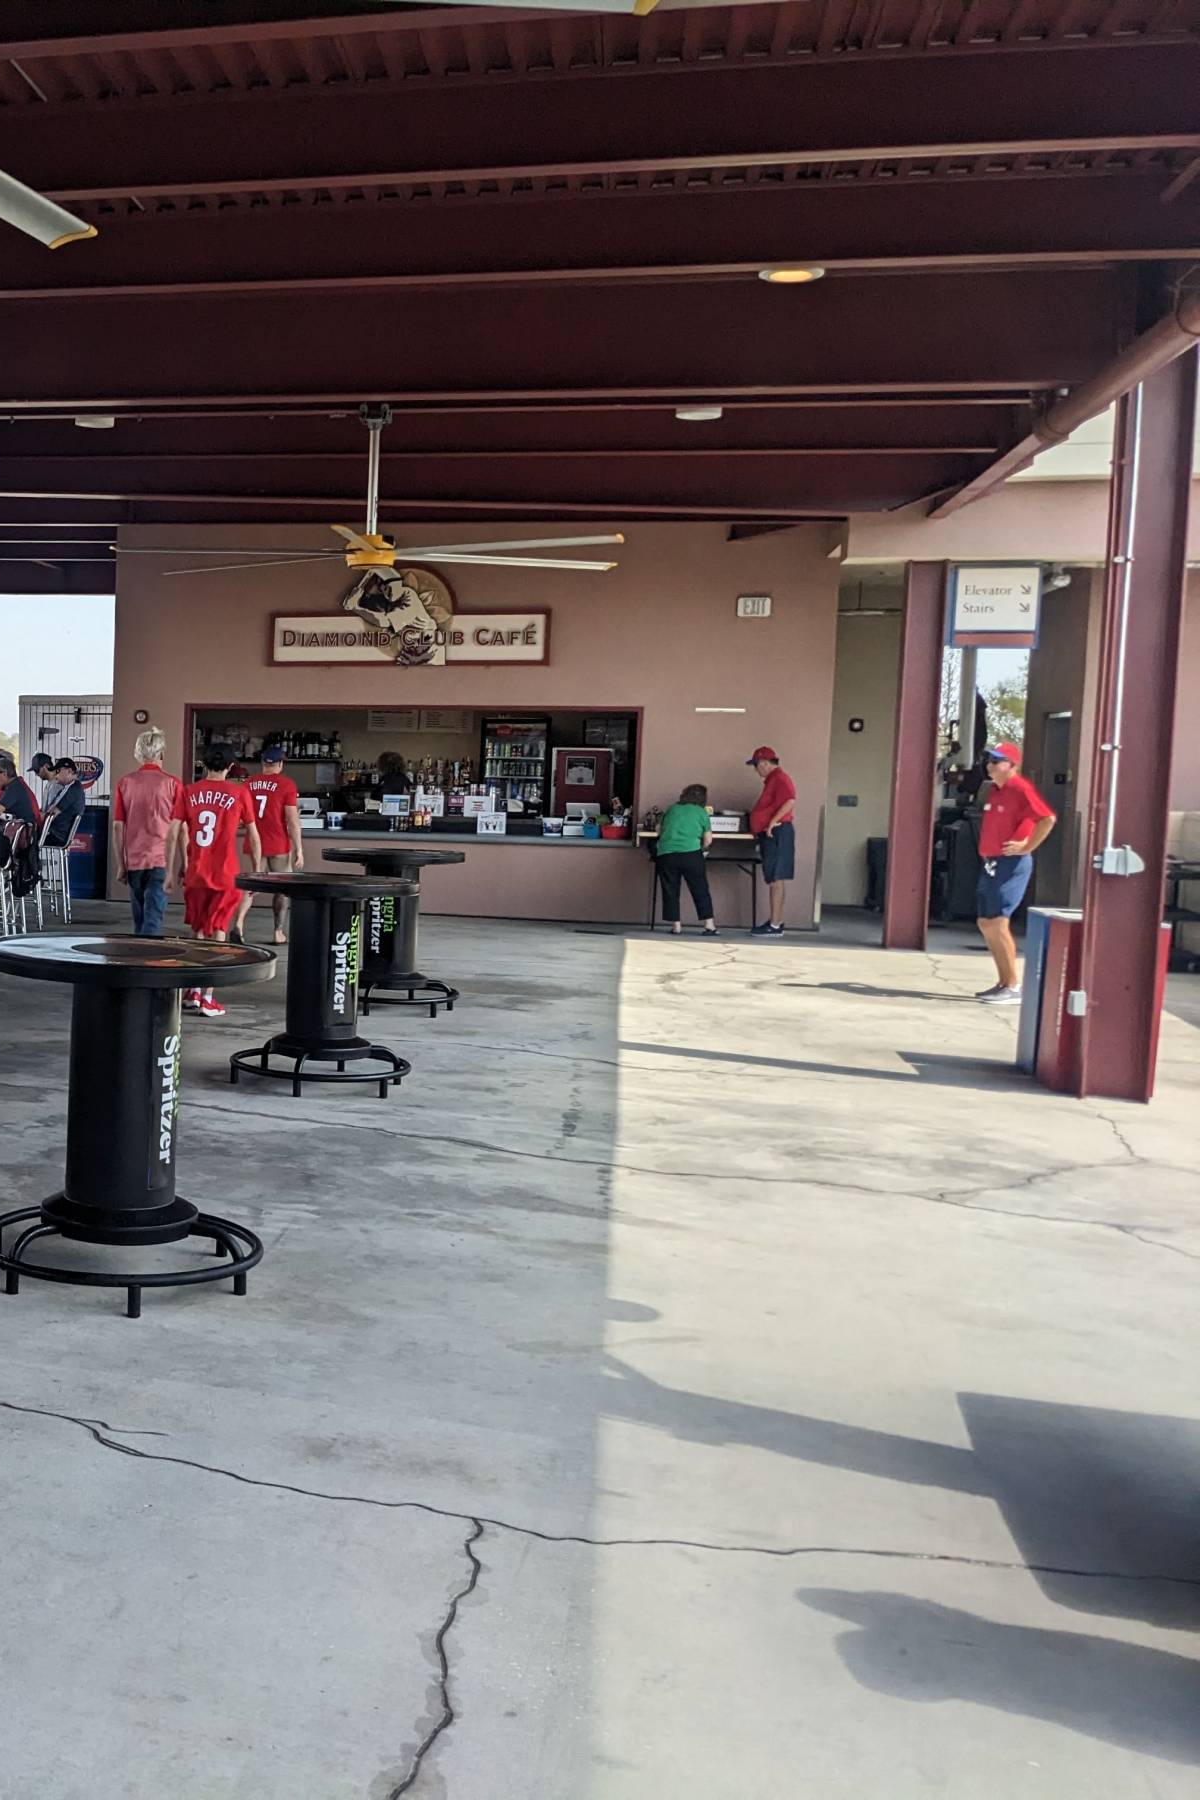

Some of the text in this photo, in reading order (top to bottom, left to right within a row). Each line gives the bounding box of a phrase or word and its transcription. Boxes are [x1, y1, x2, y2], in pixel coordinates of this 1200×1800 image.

[964, 584, 1013, 596] Elevator
[743, 599, 767, 615] EXIT
[962, 602, 995, 613] Stairs
[249, 780, 278, 792] TURNER
[189, 790, 236, 810] HARPER
[255, 795, 268, 819] 7
[195, 810, 217, 847] 3
[381, 896, 397, 932] ngria
[331, 931, 351, 1014] Spritzer
[157, 1035, 179, 1165] Spritzer
